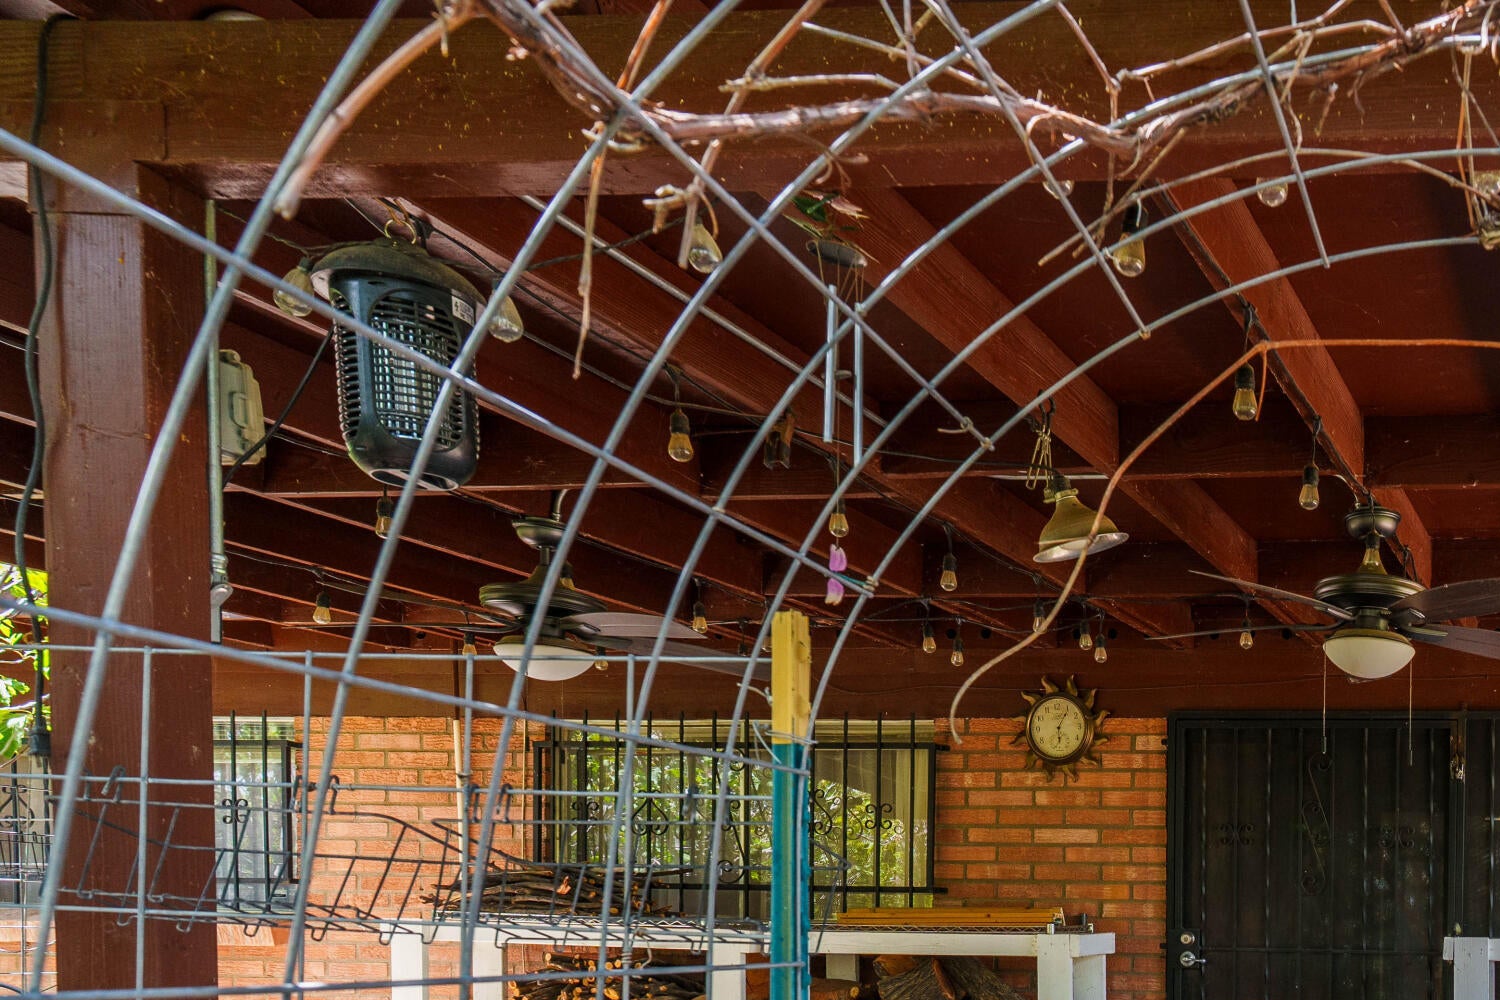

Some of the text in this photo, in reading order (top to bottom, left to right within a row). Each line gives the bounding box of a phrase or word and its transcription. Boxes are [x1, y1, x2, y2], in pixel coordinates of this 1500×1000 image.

[1044, 706, 1050, 714] 11
[1053, 703, 1061, 711] 12
[1073, 711, 1079, 720] 2
[1039, 736, 1045, 744] 8
